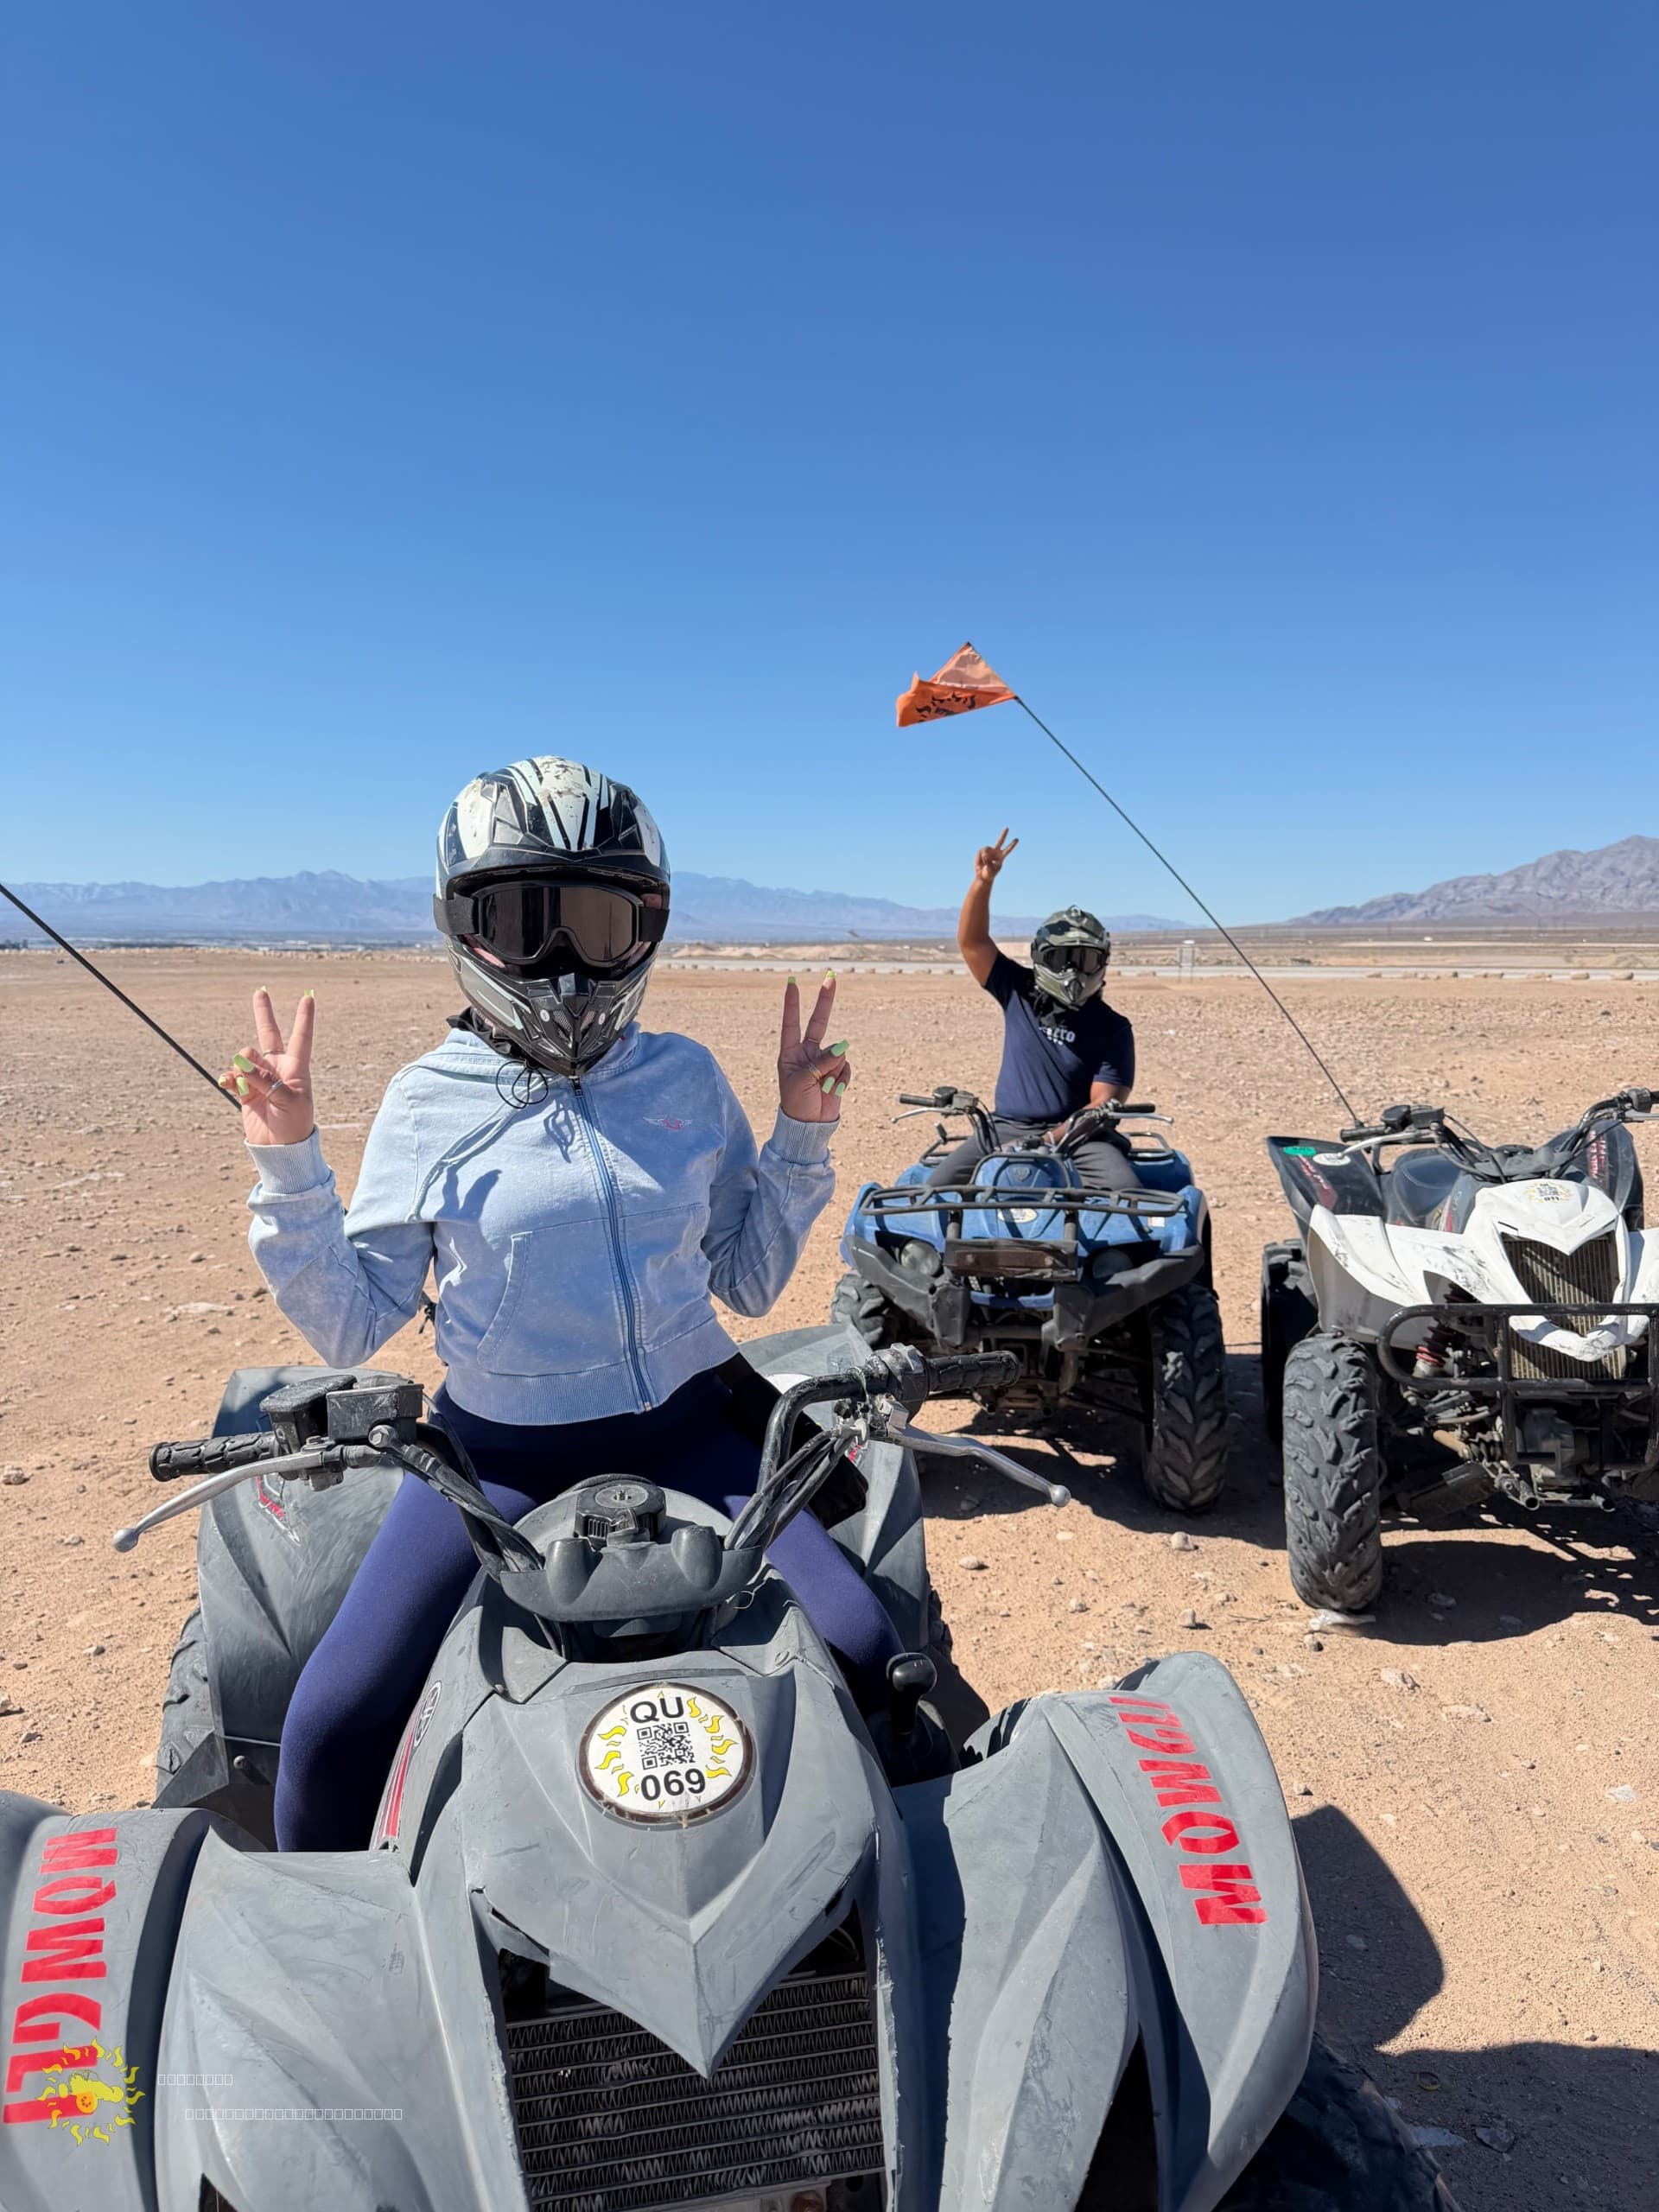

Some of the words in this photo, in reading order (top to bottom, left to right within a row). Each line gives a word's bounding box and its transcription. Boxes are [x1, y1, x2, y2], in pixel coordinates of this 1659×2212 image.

[630, 1696, 684, 1724] QU
[640, 1768, 706, 1801] 069
[1108, 1696, 1268, 1925] MOWGLI
[3, 1827, 118, 2125] MOWGLI
